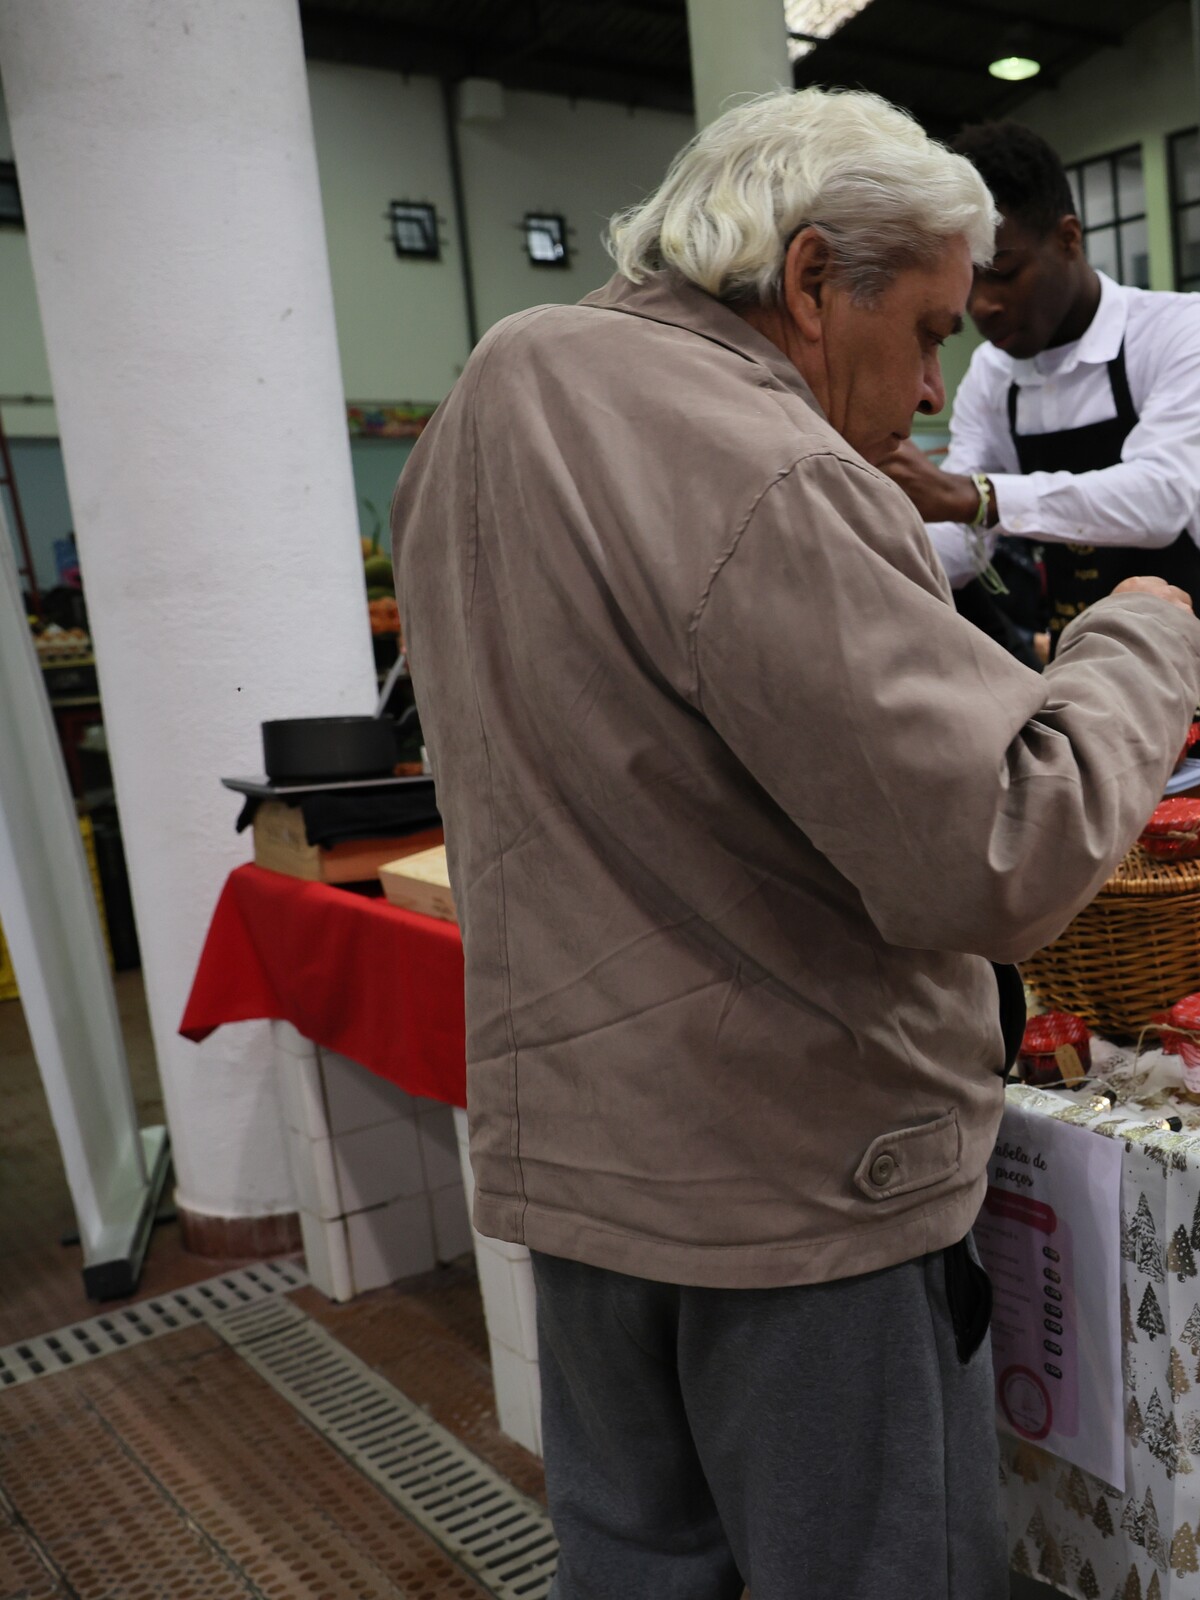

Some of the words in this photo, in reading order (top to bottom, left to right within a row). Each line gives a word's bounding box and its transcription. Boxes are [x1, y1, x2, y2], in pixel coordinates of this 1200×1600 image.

[995, 1142, 1031, 1165] abela
[1033, 1152, 1048, 1171] de
[995, 1167, 1034, 1189] preços
